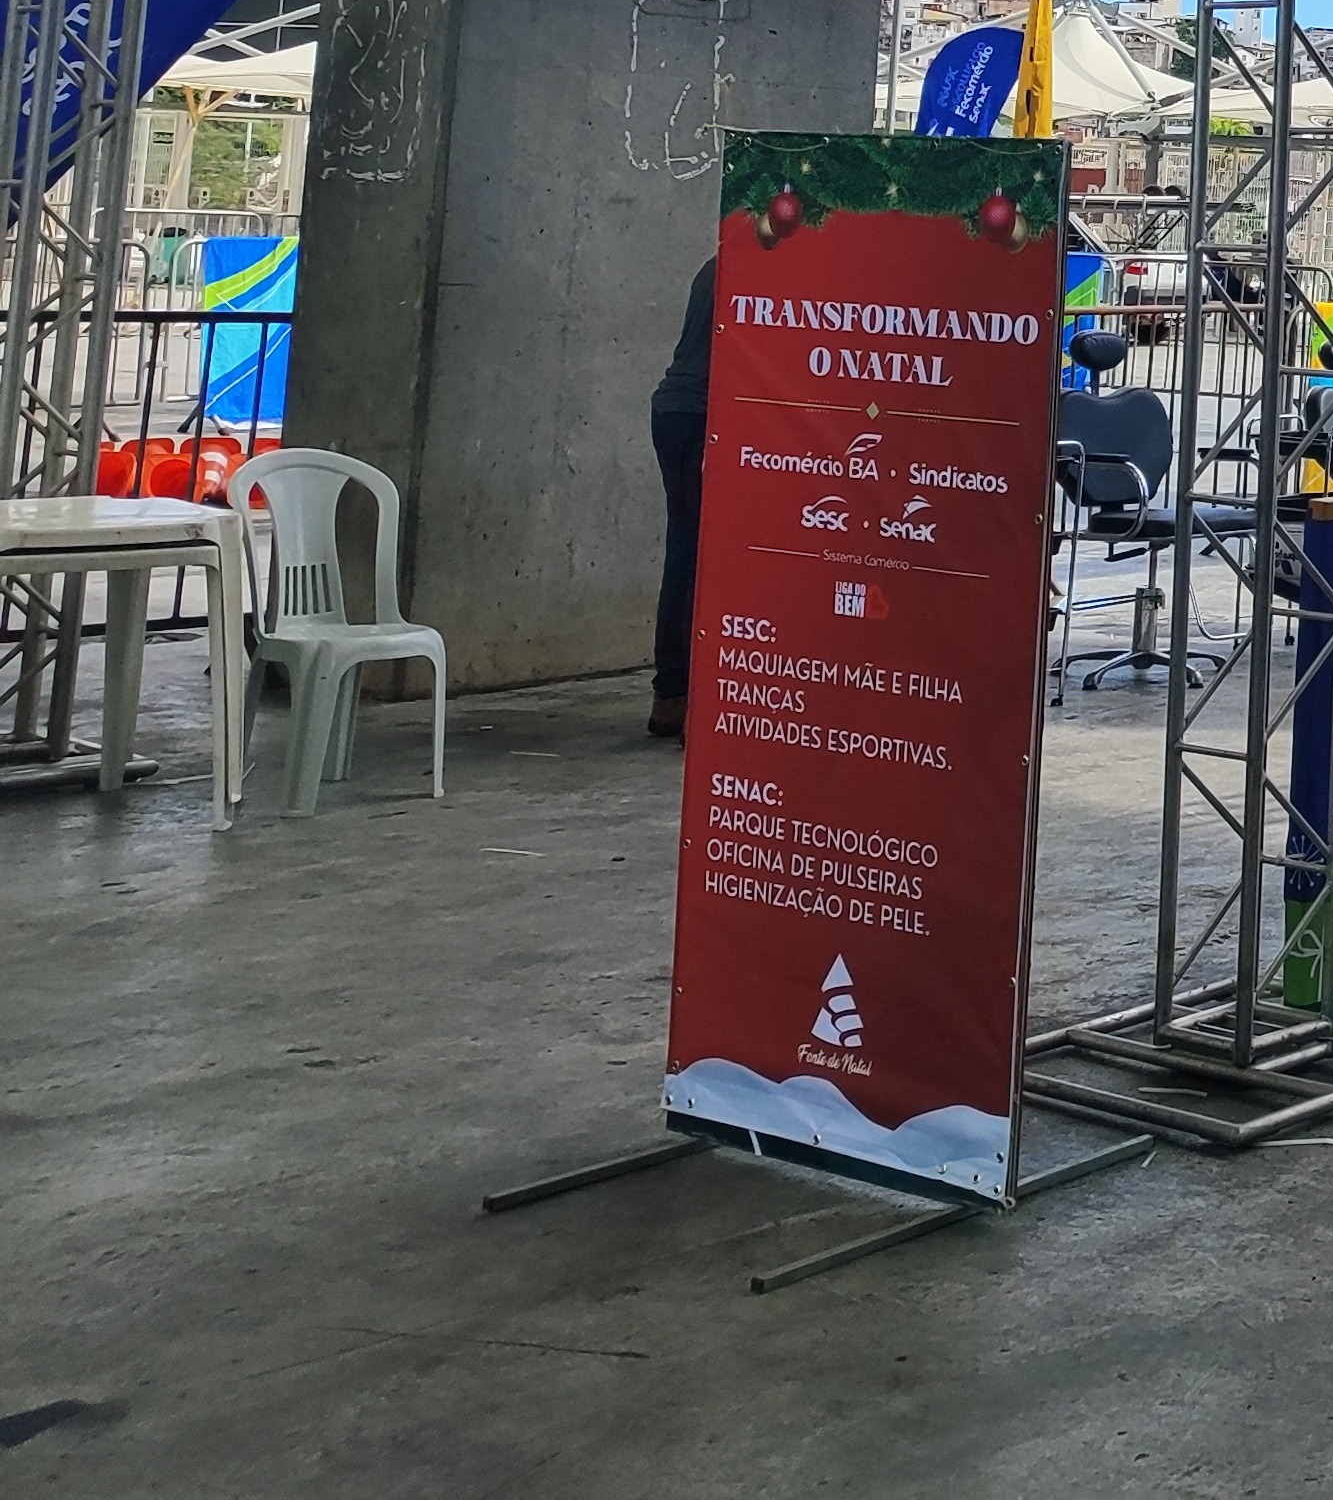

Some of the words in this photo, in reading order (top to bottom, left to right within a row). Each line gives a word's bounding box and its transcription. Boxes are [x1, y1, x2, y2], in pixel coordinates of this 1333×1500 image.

[730, 295, 1039, 345] TRANSFORMANDO
[809, 347, 832, 376] O
[838, 351, 953, 386] NATAL
[740, 446, 843, 477] Fecomércio
[849, 458, 878, 480] BA
[909, 463, 1008, 493] Sindicatos
[801, 505, 849, 532] Sesc
[879, 517, 937, 543] Senac
[823, 549, 861, 566] Sistema
[864, 553, 909, 570] Comércio
[834, 594, 866, 618] BEM
[835, 581, 852, 595] LIGA
[854, 583, 866, 596] DO
[721, 615, 777, 644] SESC:
[718, 647, 839, 687] MAQUIAGEM
[844, 662, 887, 693] MÃE
[892, 671, 902, 695] E
[909, 674, 962, 703] FILHA
[716, 679, 805, 714] TRANÇAS
[715, 712, 822, 749] ATIVIDADES
[827, 730, 952, 771] ESPORTIVAS.
[711, 774, 783, 806] SENAC:
[709, 805, 786, 841] PARQUE
[791, 820, 938, 868] TECNOLÓGICO
[707, 840, 784, 874] OFICINA
[791, 855, 814, 879] DE
[821, 859, 923, 900] PULSEIRAS
[704, 871, 843, 918] HIGIENIZAÇÃO
[848, 901, 874, 925] DE
[881, 907, 930, 936] PELE.
[797, 1044, 826, 1068] Fonte
[828, 1053, 841, 1071] de
[843, 1053, 873, 1077] Natal
